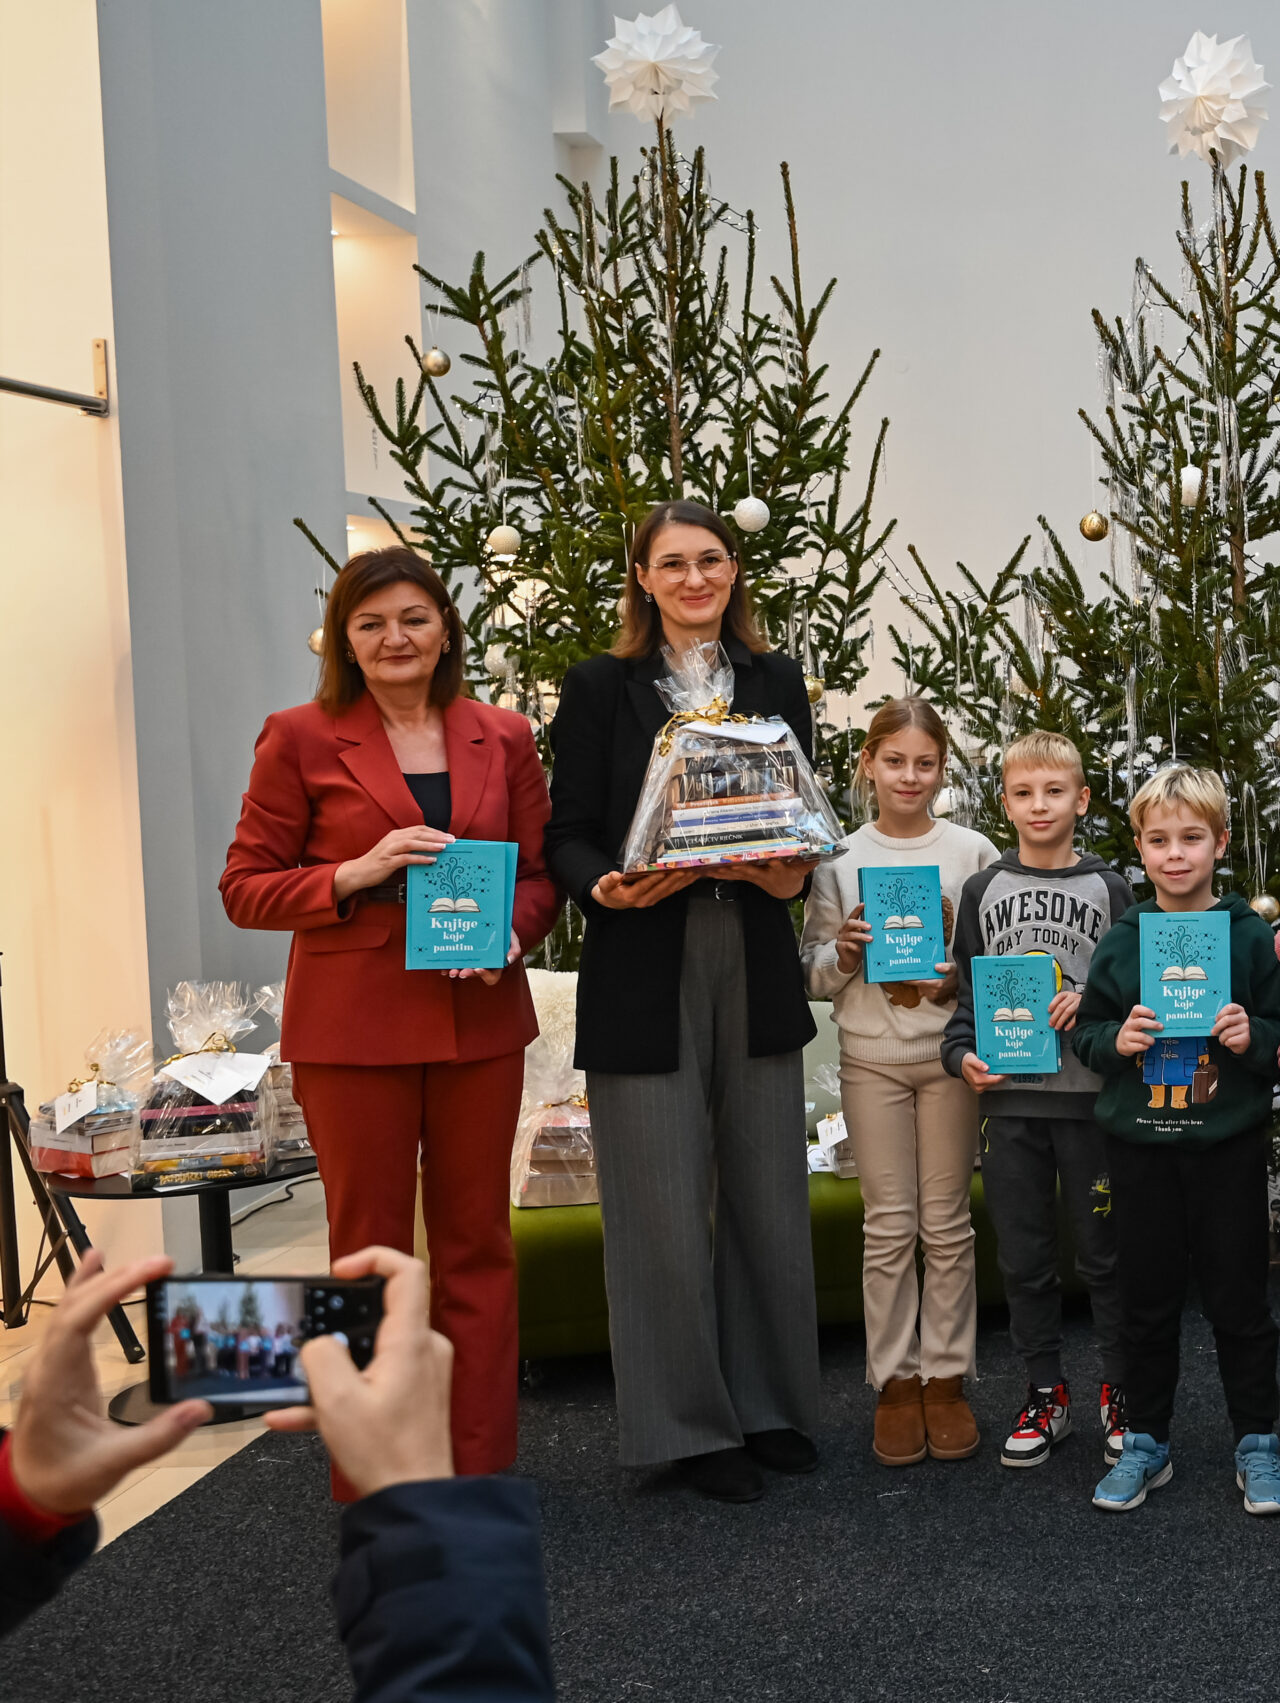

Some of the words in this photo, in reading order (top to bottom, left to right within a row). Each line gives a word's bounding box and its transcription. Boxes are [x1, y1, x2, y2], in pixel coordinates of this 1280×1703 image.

[985, 890, 1102, 946] AWESOME
[431, 918, 478, 931] Knjige
[443, 932, 464, 942] koje
[886, 934, 923, 946] Knjige
[997, 930, 1023, 955] DAY
[1032, 928, 1079, 955] TODAY
[433, 944, 473, 953] pamtim
[896, 946, 913, 955] koje
[889, 957, 921, 966] pamtim
[1163, 986, 1206, 1000] Knjige
[1174, 1000, 1194, 1010] koje
[1166, 1011, 1202, 1021] pamtim
[995, 1026, 1033, 1039] Knjige
[1006, 1039, 1023, 1048] koje
[999, 1050, 1031, 1059] pamtim
